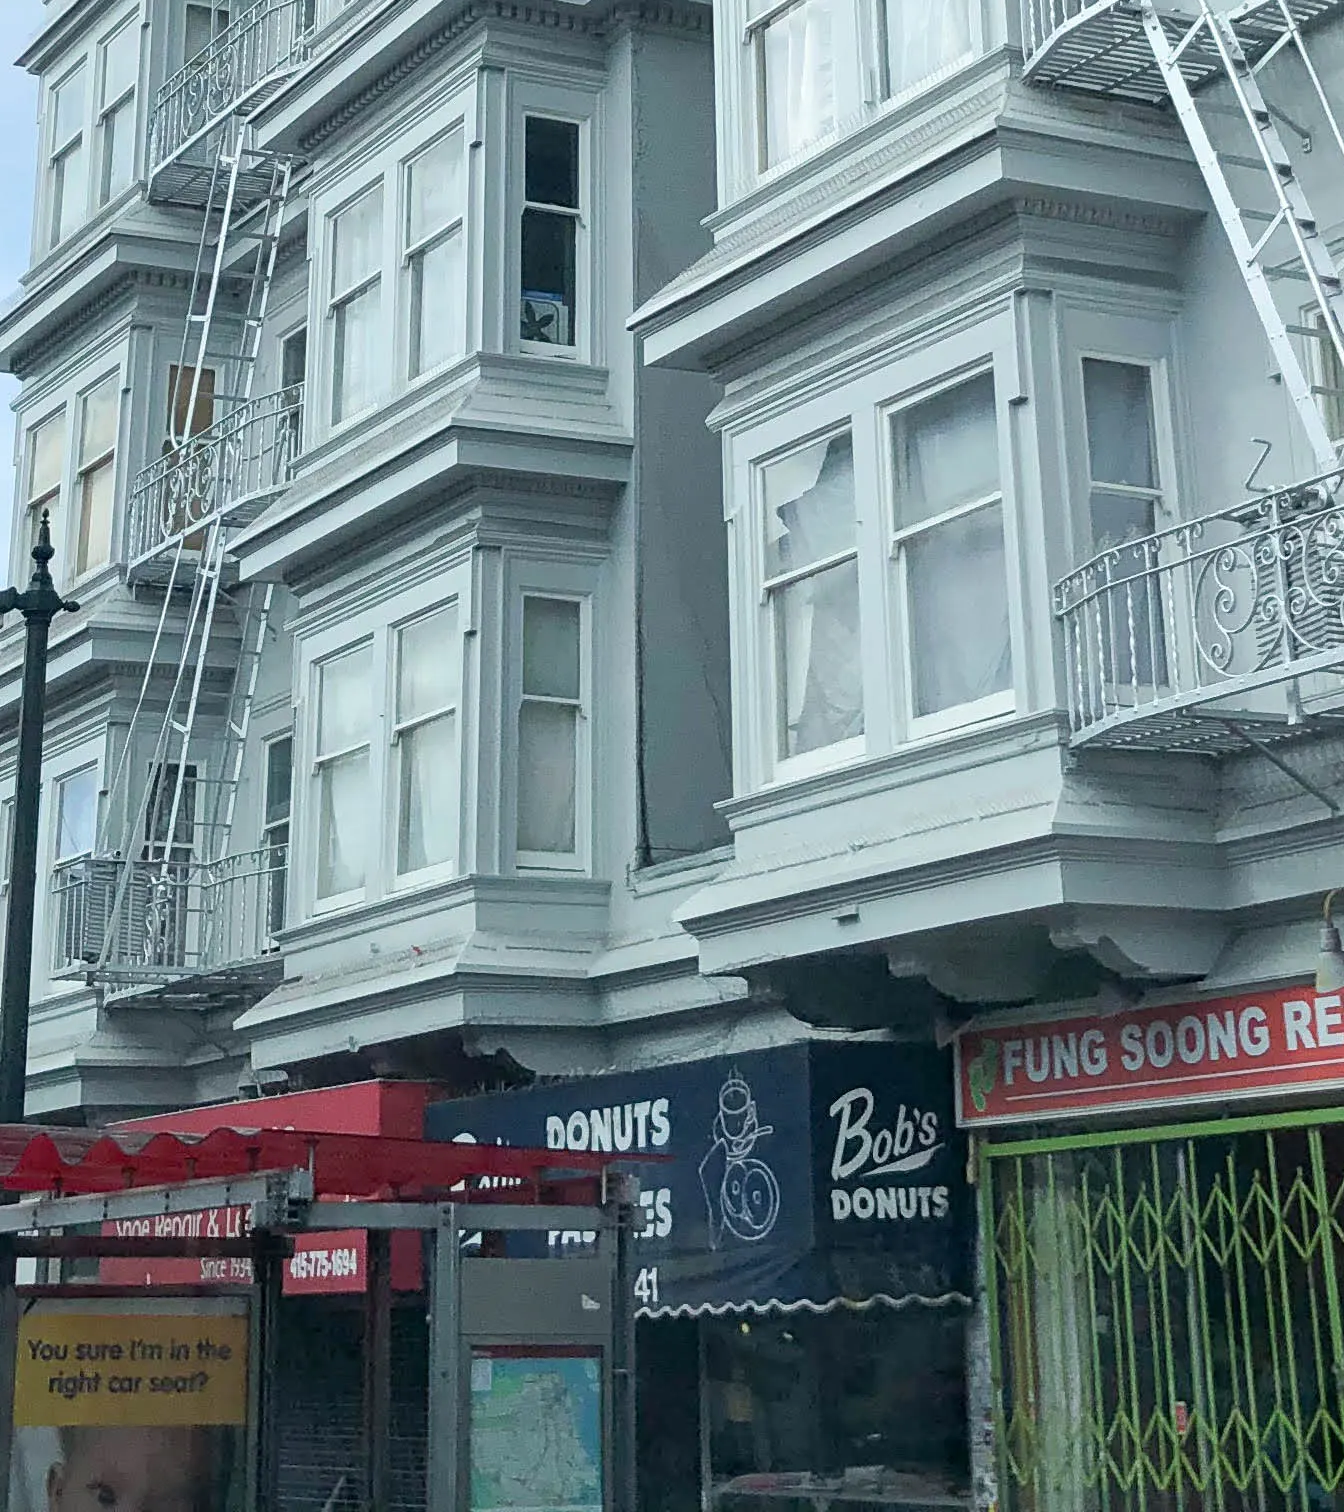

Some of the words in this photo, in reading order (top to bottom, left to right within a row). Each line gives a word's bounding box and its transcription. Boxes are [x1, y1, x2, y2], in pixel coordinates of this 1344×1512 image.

[1005, 1029, 1108, 1086] FUNG
[1120, 1006, 1270, 1071] SOONG
[546, 1098, 670, 1152] DONUTS
[829, 1088, 938, 1181] Bob's
[831, 1186, 949, 1220] DONUTS
[200, 1257, 226, 1279] Since
[28, 1339, 68, 1361] You
[76, 1342, 124, 1360] sure
[130, 1339, 163, 1361] I'm
[170, 1339, 190, 1361] in
[196, 1338, 232, 1361] the
[48, 1370, 101, 1399] right
[108, 1376, 143, 1393] car
[149, 1371, 208, 1393] seat?
